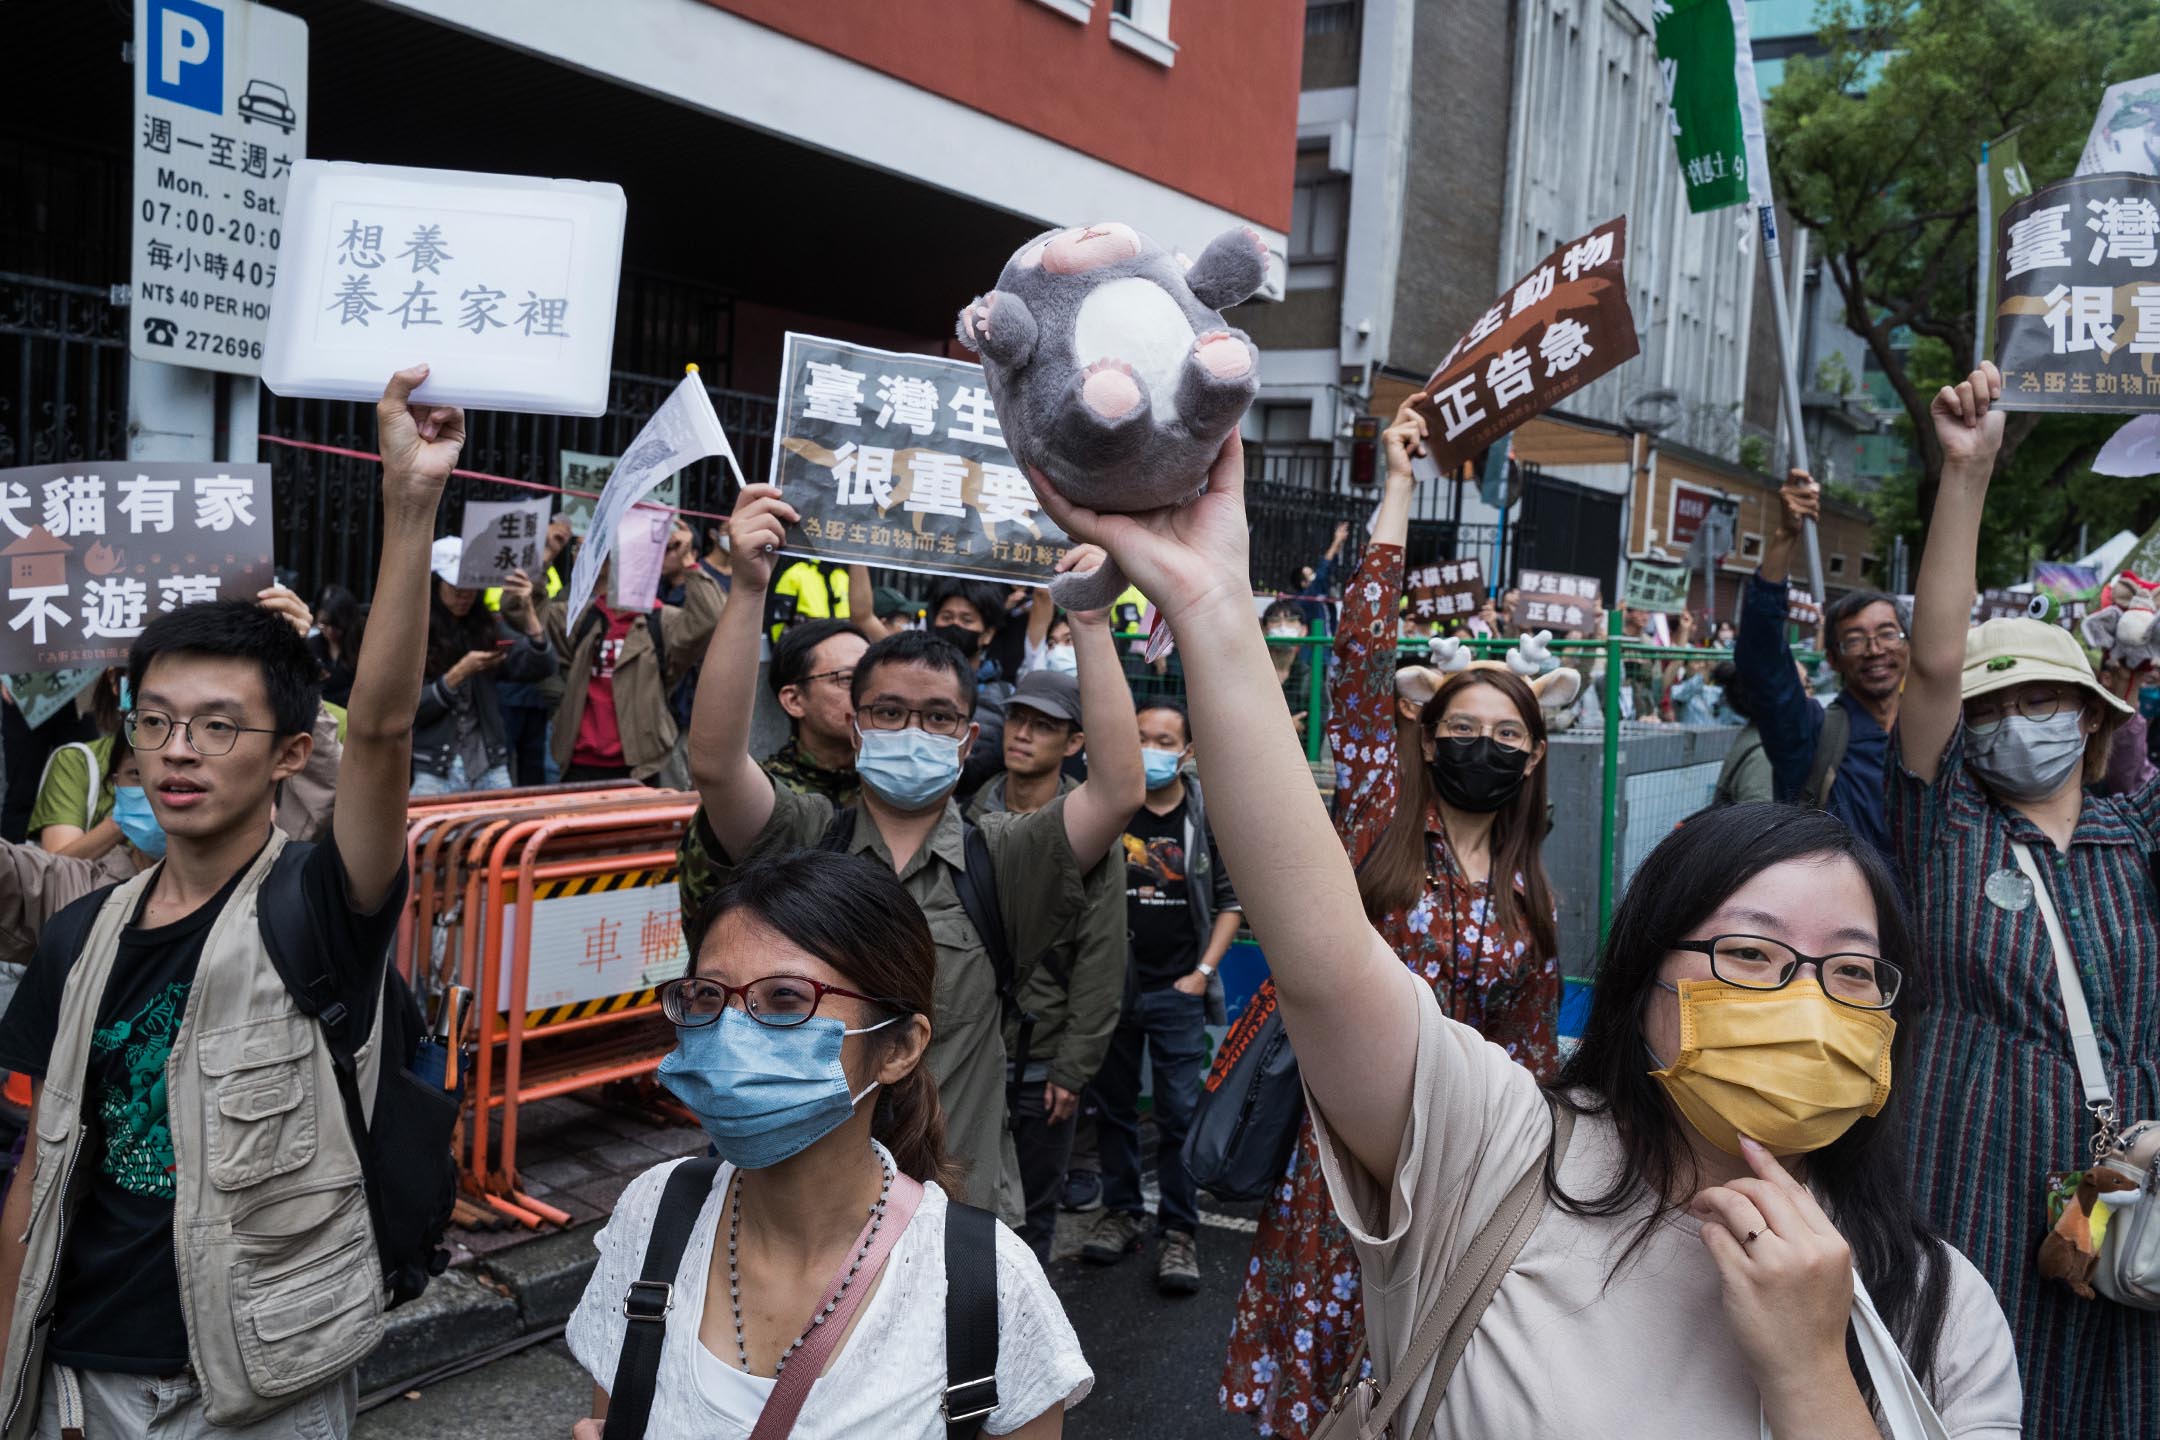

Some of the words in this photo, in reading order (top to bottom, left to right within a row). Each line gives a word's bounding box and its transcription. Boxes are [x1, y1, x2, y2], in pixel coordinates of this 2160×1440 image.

[161, 7, 210, 86] P
[143, 113, 293, 180] 週一至週六
[157, 167, 209, 199] Mon.
[243, 189, 281, 216] Sat.
[337, 219, 454, 275] 想養
[2005, 197, 2160, 281] 臺灣
[142, 282, 175, 305] NT$
[180, 290, 199, 309] 40
[204, 294, 238, 316] PER
[243, 301, 271, 321] HO
[326, 273, 571, 338] 養在家裡
[185, 330, 266, 360] 272696
[802, 361, 1008, 449] 臺灣生
[1433, 318, 1594, 442] 正告急
[0, 474, 256, 539] 犬貓有家
[831, 441, 1040, 528] 很重要
